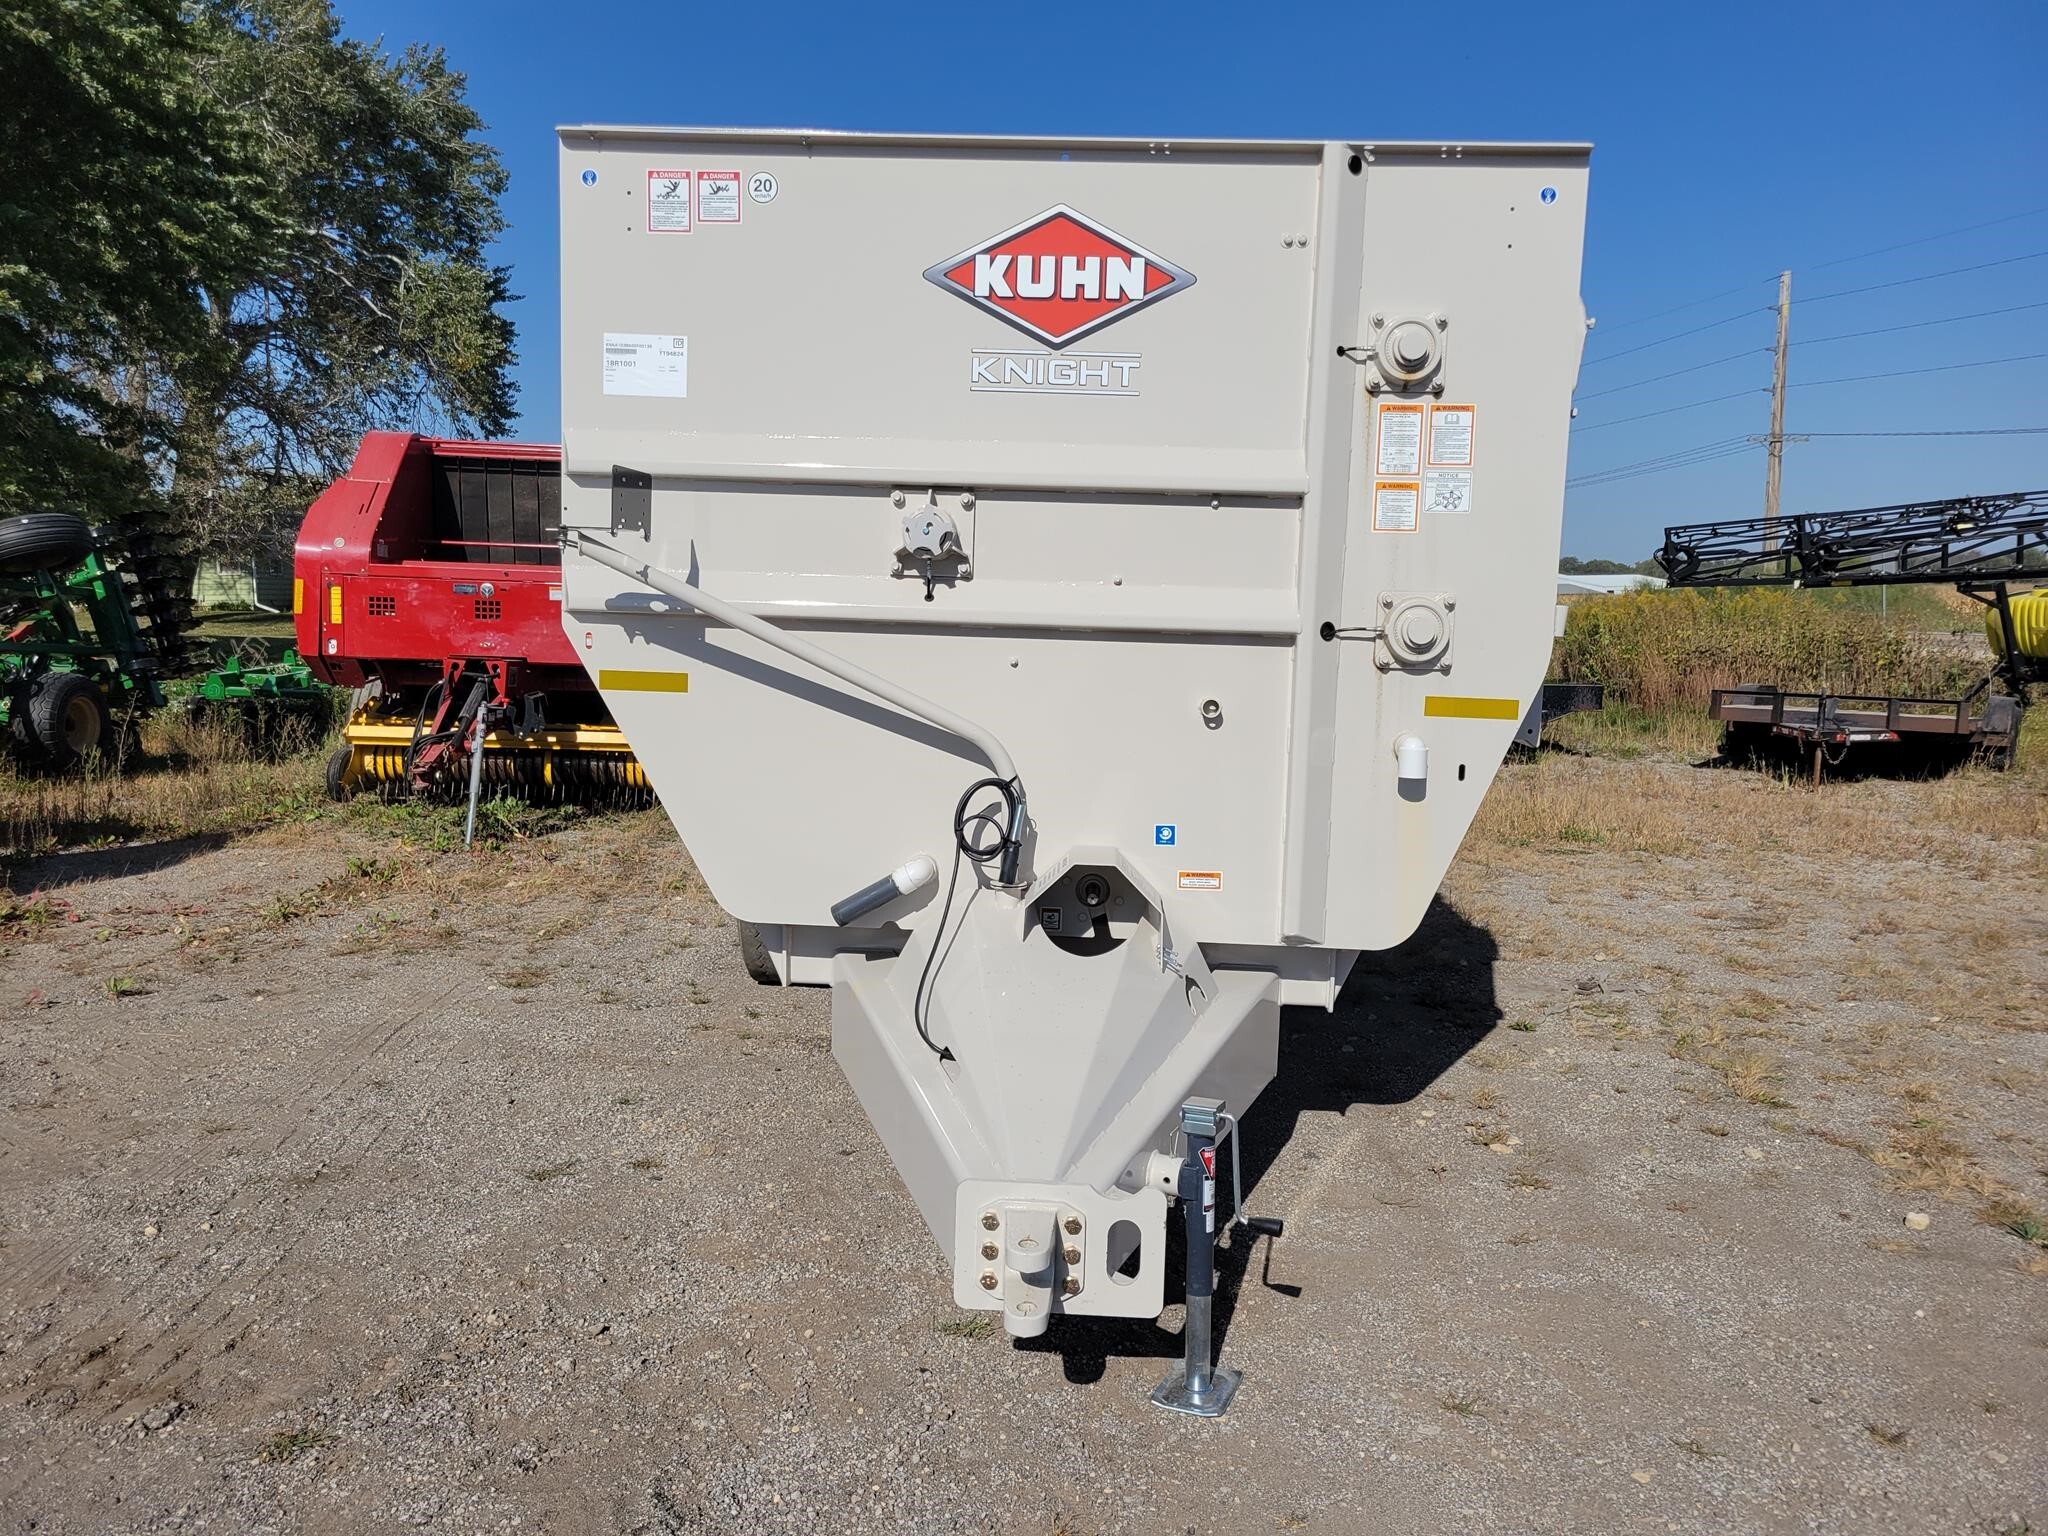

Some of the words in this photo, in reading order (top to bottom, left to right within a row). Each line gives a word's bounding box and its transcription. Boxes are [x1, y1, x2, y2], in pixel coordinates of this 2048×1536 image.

[753, 178, 773, 193] 20
[973, 254, 1146, 300] KUHN
[971, 357, 1141, 387] KNIGHT
